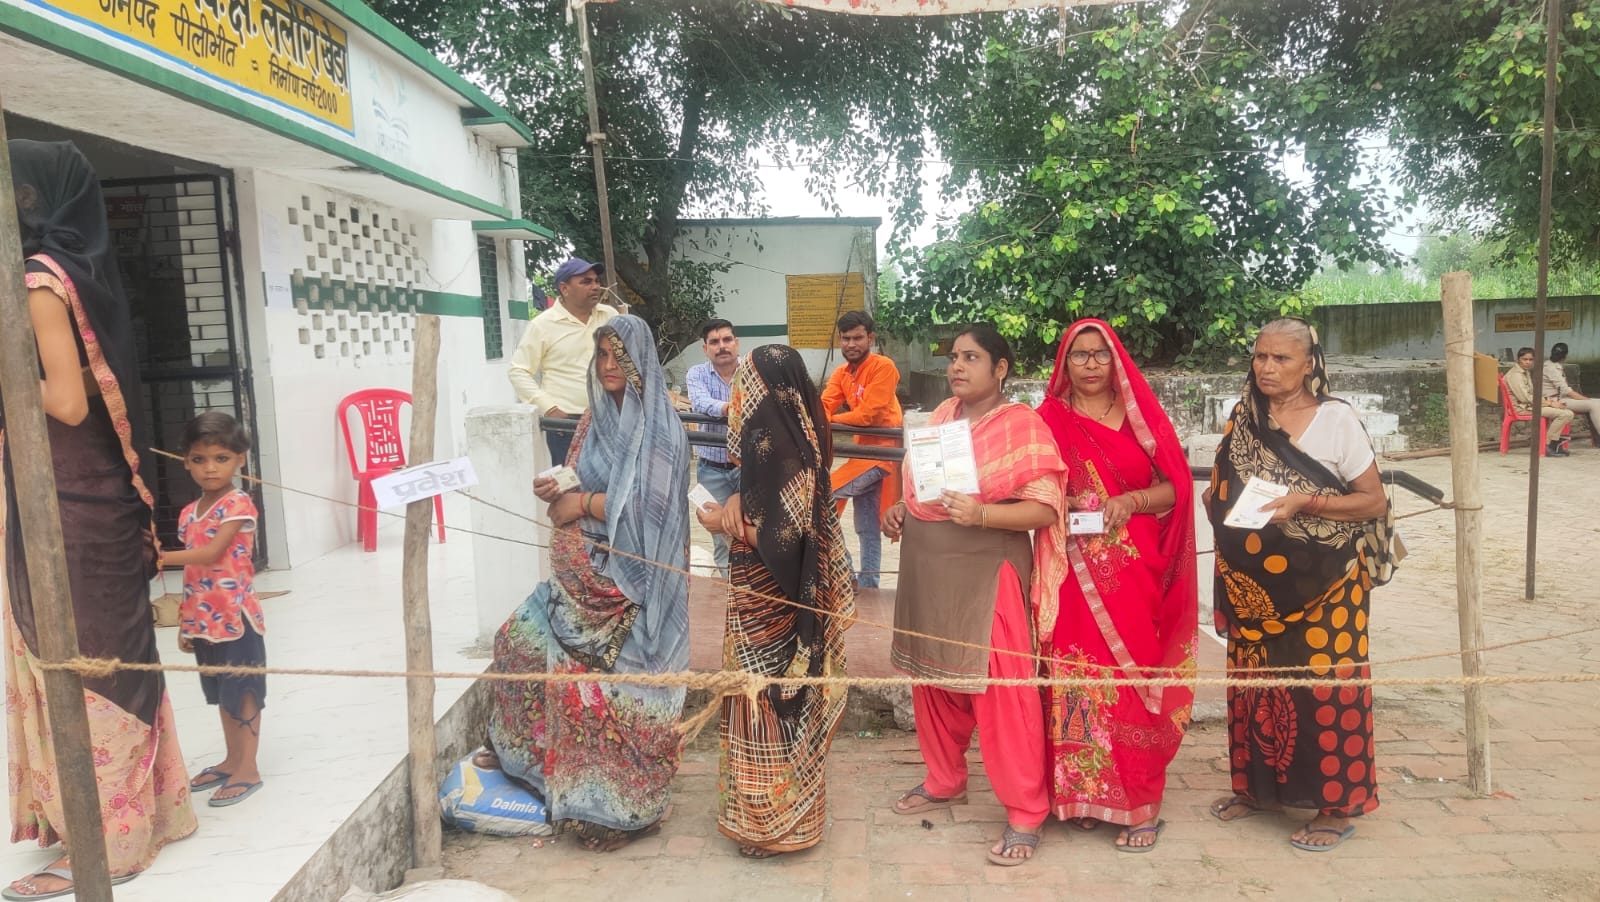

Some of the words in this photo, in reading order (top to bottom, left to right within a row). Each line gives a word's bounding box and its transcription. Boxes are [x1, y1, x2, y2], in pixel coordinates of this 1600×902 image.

[169, 3, 238, 67] पीलीभीत
[268, 53, 299, 98] निर्माण
[491, 798, 538, 814] Dalmia
